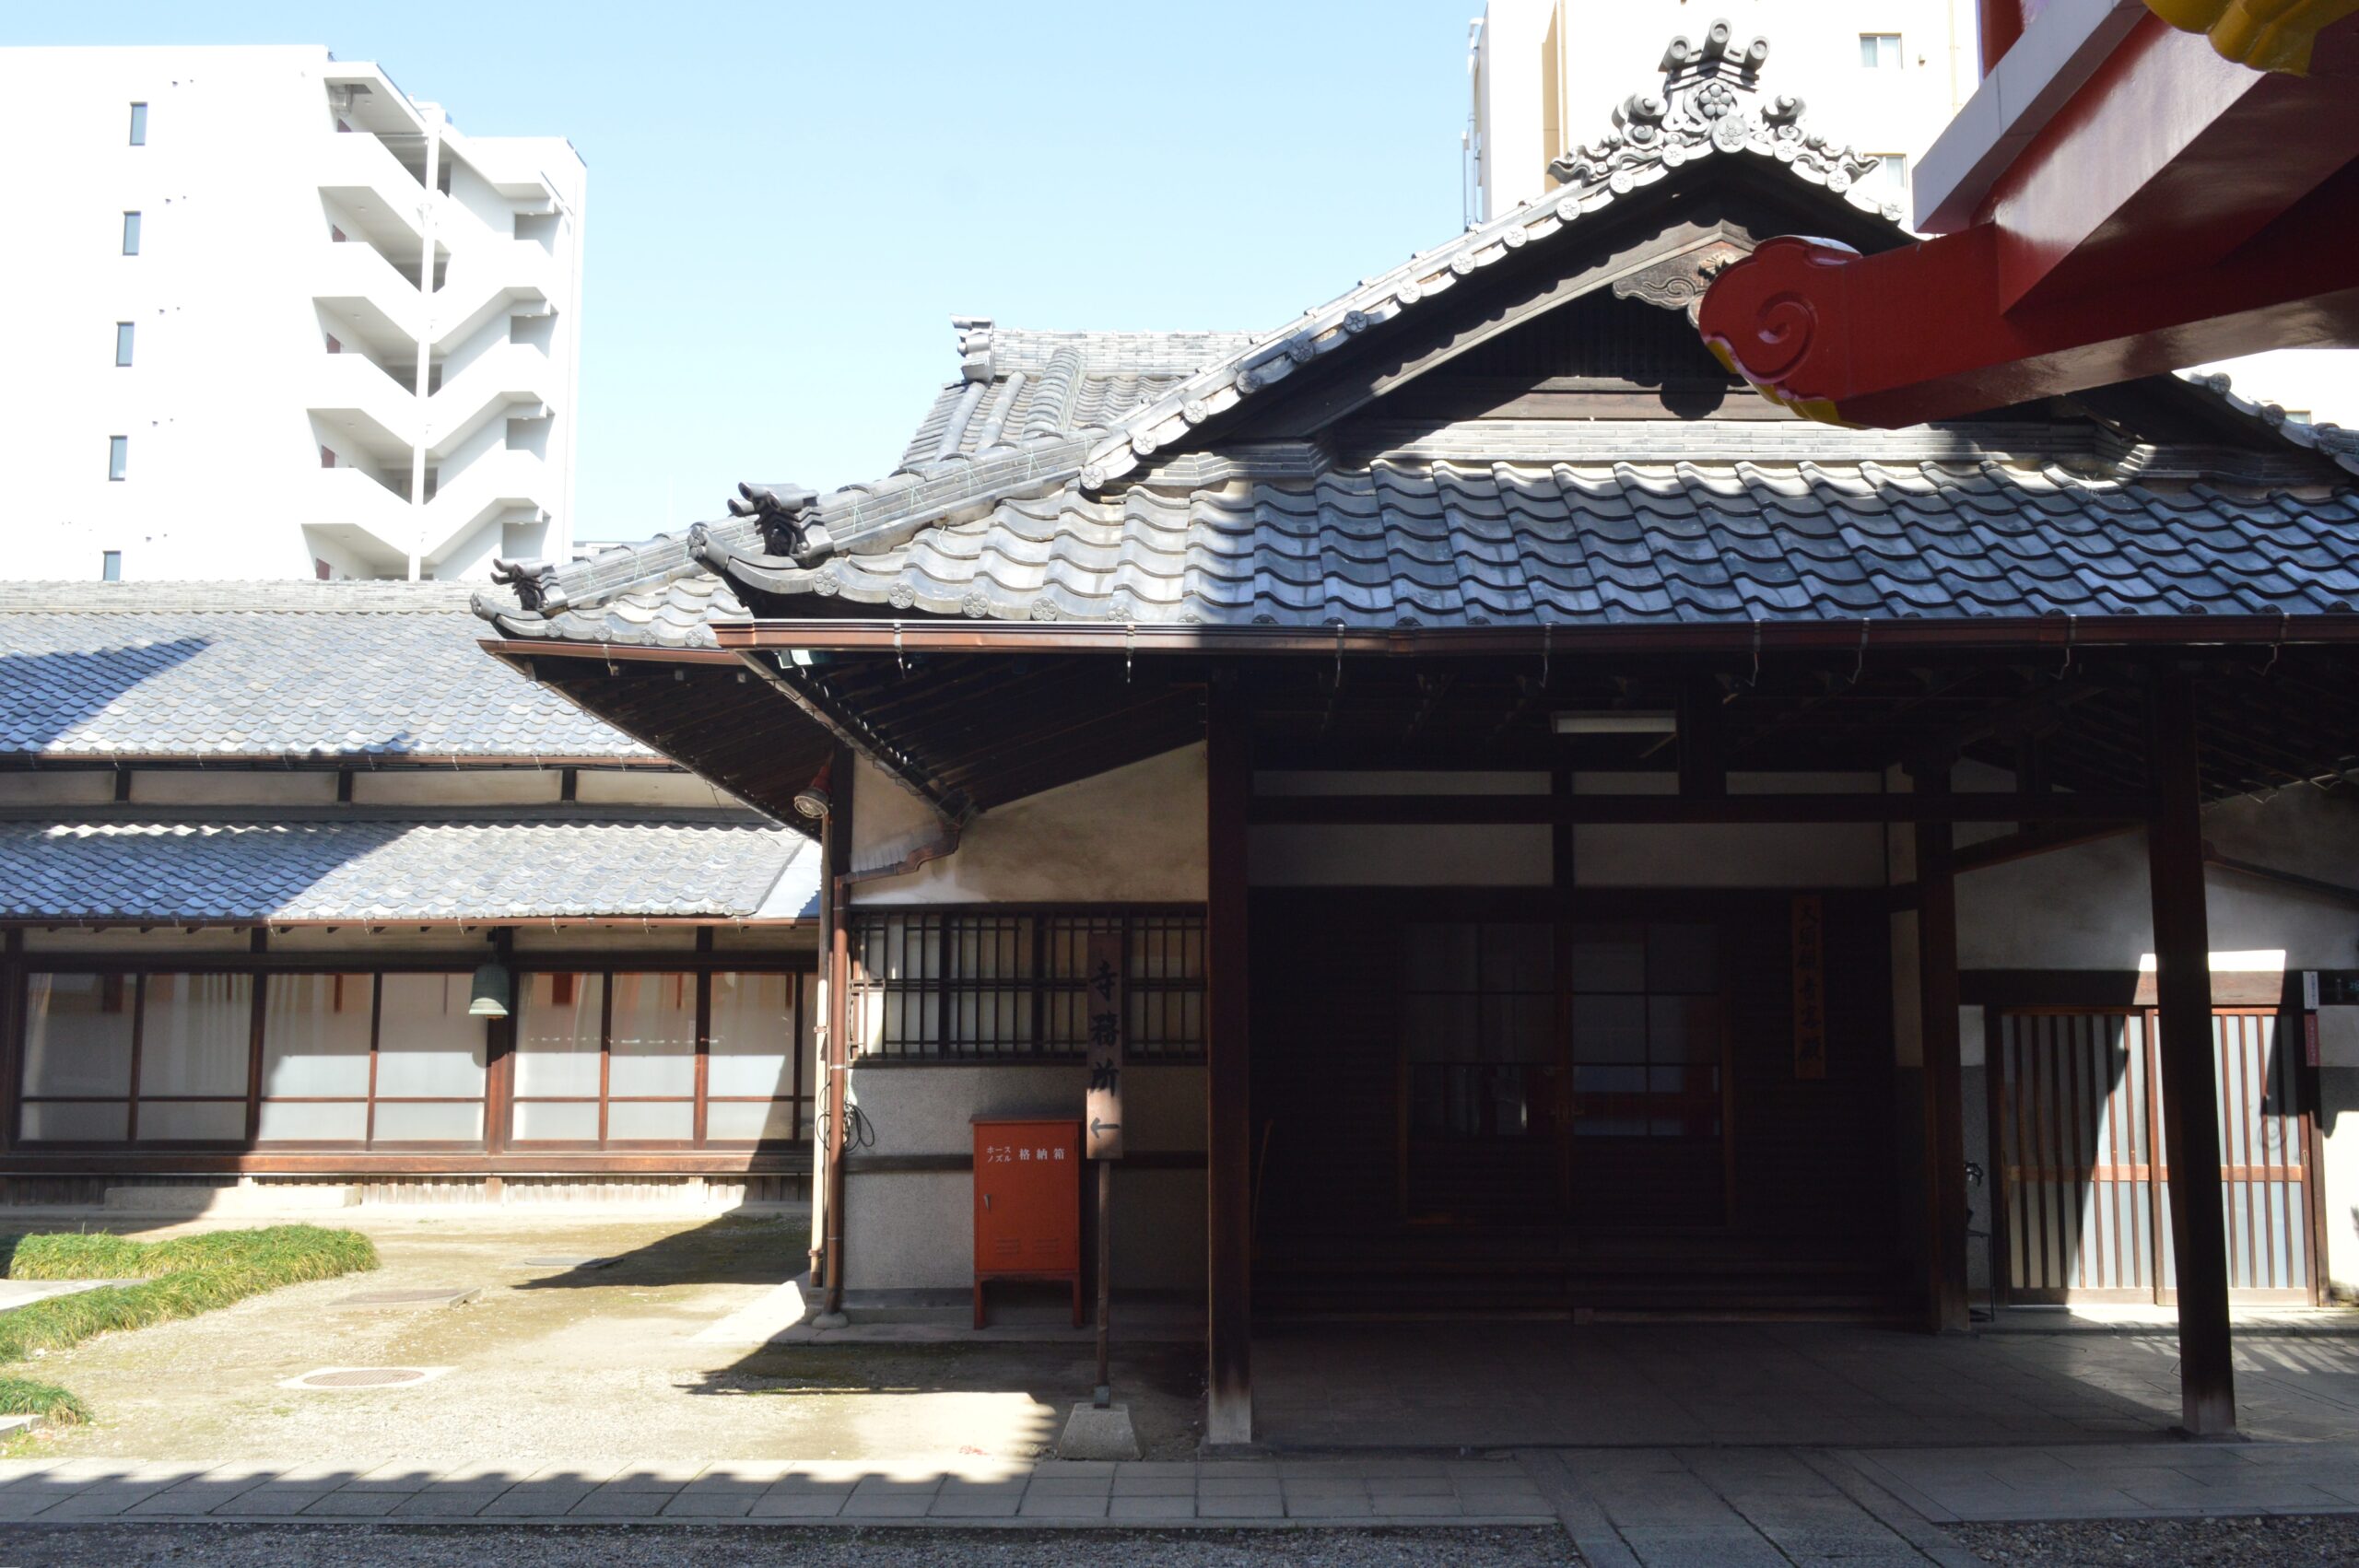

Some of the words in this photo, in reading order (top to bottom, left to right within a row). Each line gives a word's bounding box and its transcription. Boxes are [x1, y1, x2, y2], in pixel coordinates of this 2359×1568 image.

[1089, 959, 1120, 1097] 寺務所
[987, 1145, 1011, 1154] ホース
[1019, 1148, 1066, 1162] 格納箱
[987, 1154, 1011, 1164] ノズル
